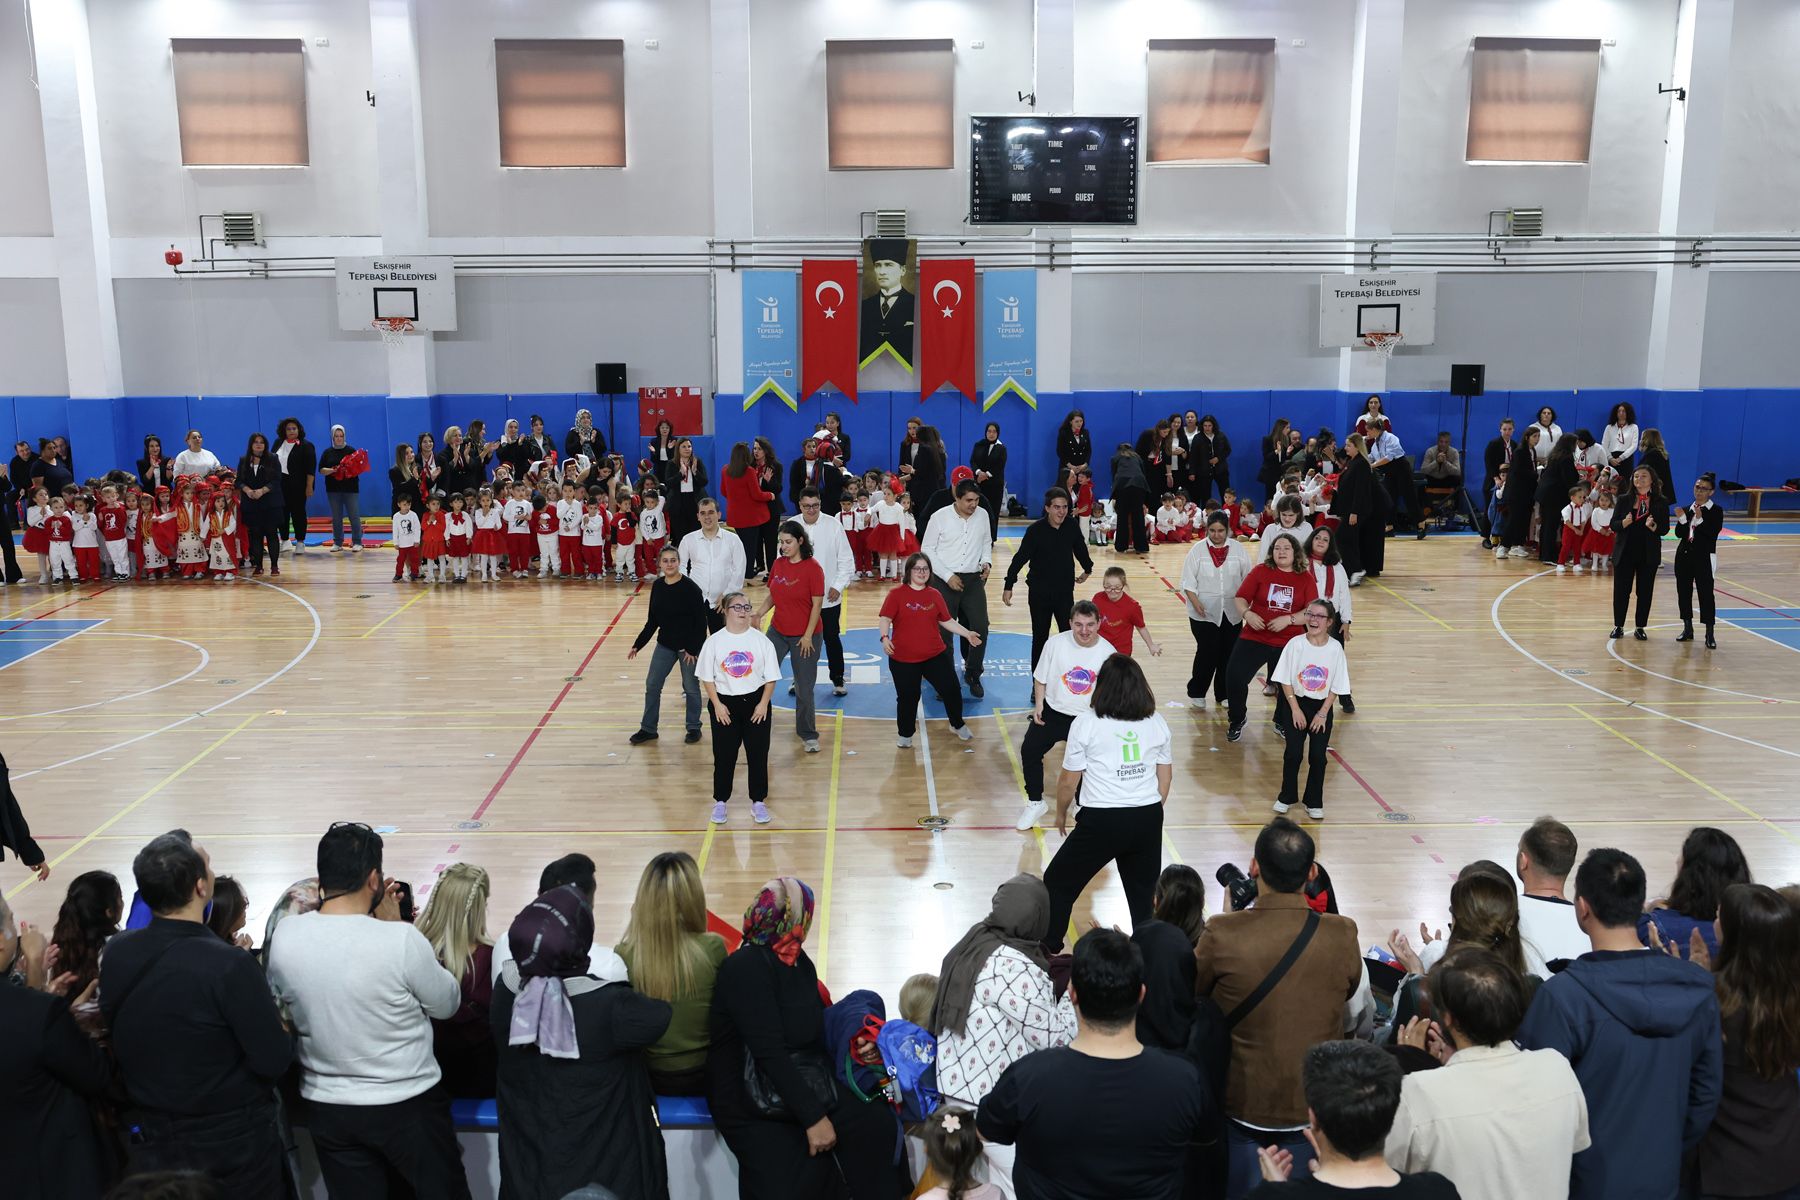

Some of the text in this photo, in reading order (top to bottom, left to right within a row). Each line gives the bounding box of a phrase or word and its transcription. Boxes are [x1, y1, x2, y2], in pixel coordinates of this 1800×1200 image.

[1047, 140, 1063, 148] TIME
[1012, 193, 1031, 202] HOME
[1075, 193, 1095, 202] GUEST
[348, 271, 437, 282] TEPEBAŞI BELEDİYESİ
[1334, 287, 1421, 299] TEPEBAŞI BELEDİYESİ
[1116, 767, 1147, 777] TEPEBAŞI
